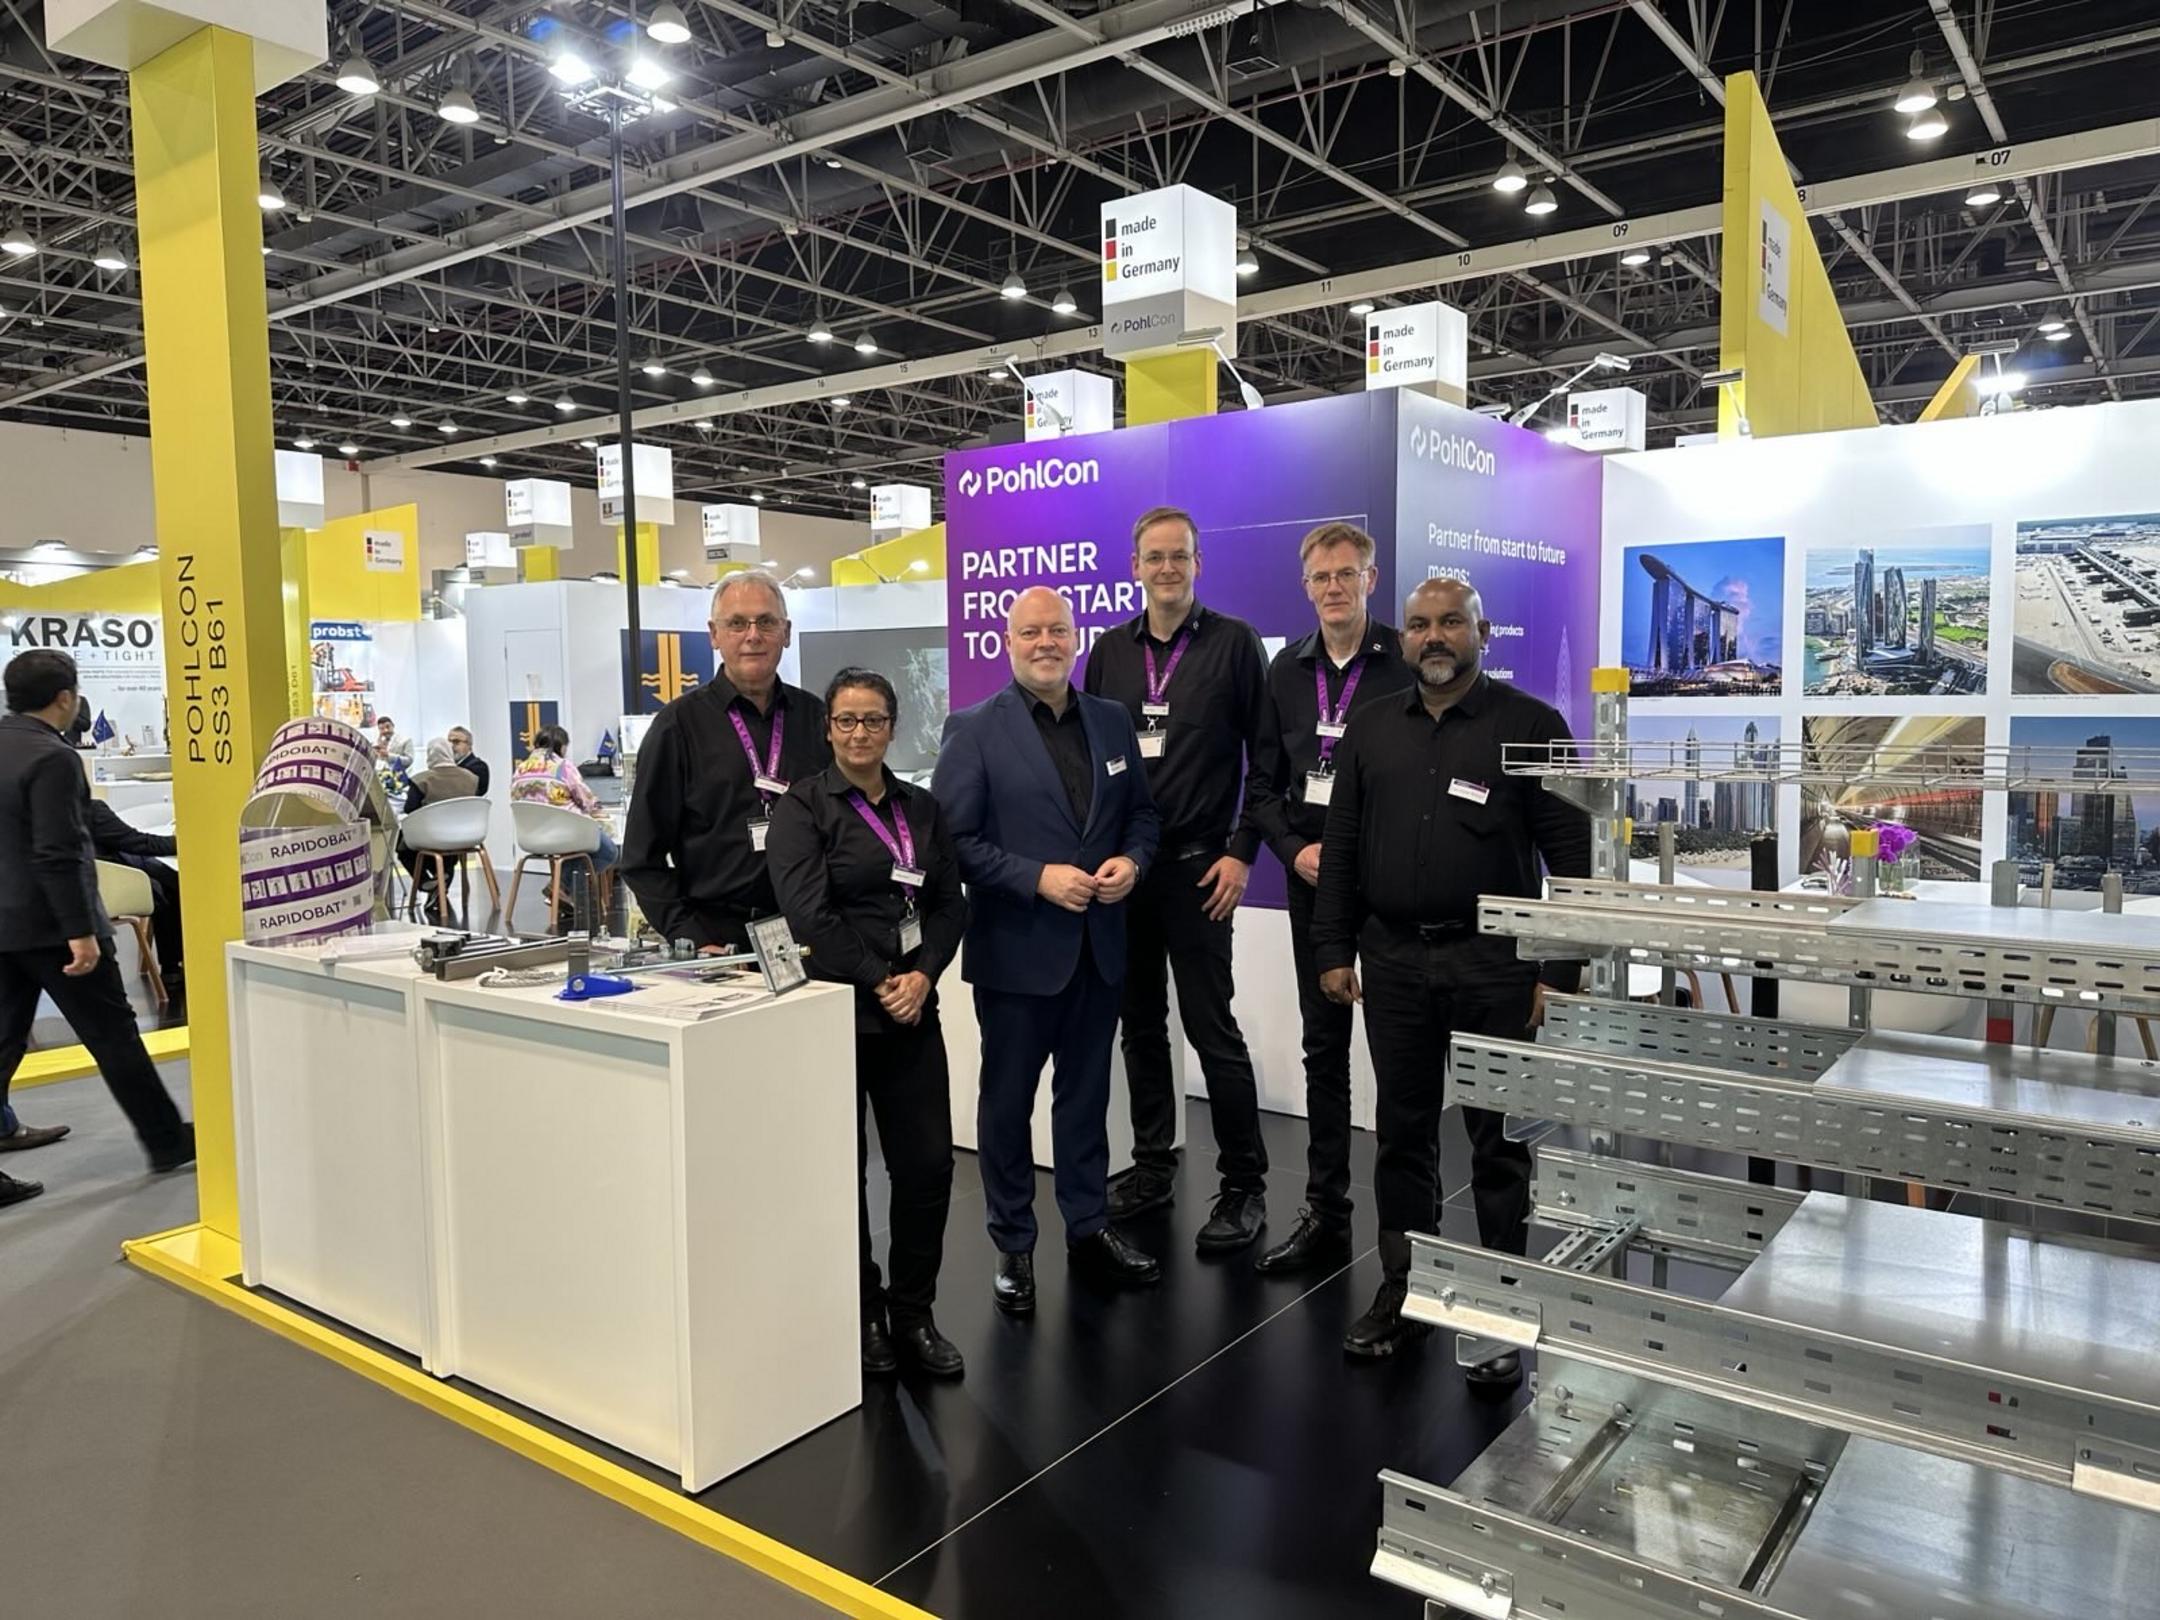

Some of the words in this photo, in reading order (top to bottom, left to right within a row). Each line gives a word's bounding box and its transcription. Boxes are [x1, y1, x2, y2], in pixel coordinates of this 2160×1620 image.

[1990, 150, 2011, 167] 07
[1797, 189, 1806, 202] 8
[1121, 215, 1157, 236] made
[1613, 224, 1629, 238] 09
[1121, 243, 1133, 258] in
[1122, 256, 1181, 279] Germany
[1458, 253, 1470, 267] 10
[1321, 280, 1332, 293] 11
[1124, 313, 1176, 333] PohlCon
[1383, 324, 1415, 340] made
[1088, 327, 1099, 340] 13
[1383, 345, 1394, 356] in
[1383, 355, 1435, 373] Germany
[1581, 404, 1608, 415] made
[1581, 416, 1590, 427] in
[1581, 428, 1624, 440] Germany
[1430, 428, 1495, 476] PohlCon
[986, 458, 1099, 495] PohlCon
[1428, 522, 1473, 550] Partner
[1474, 529, 1500, 555] from
[1501, 538, 1526, 559] start
[1526, 543, 1537, 562] to
[1538, 541, 1566, 566] future
[963, 541, 1098, 580] PARTNER
[1428, 565, 1470, 585] means:
[963, 587, 1022, 620] FRO
[1056, 580, 1148, 614] START
[12, 617, 154, 648] KRASO
[206, 599, 228, 670] B61
[313, 625, 362, 640] probst
[963, 630, 1001, 661] TO
[105, 650, 155, 661] TIGHT
[177, 555, 206, 763] POHLCON
[211, 685, 233, 765] SS3
